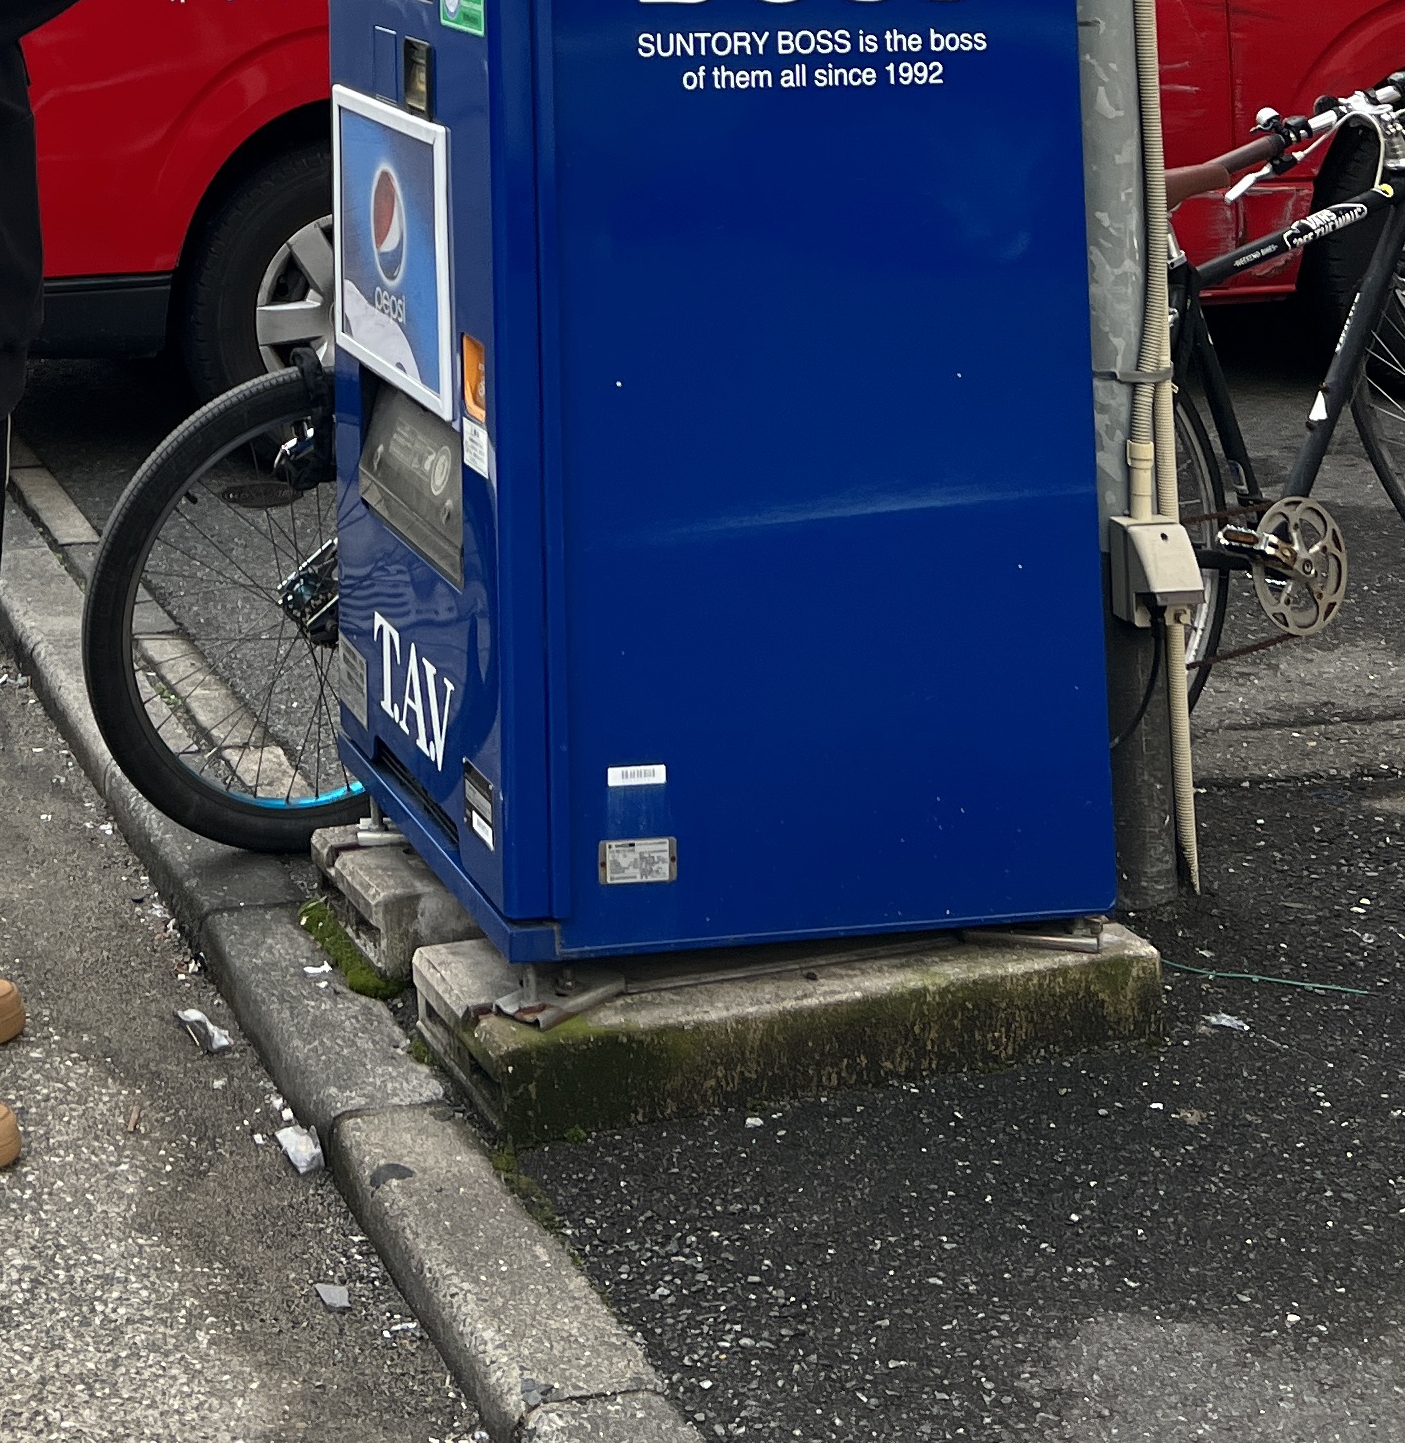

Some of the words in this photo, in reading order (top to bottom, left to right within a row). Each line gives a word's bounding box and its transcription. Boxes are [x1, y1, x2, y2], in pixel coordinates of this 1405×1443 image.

[637, 31, 770, 58] SUNTORY
[777, 29, 851, 56] BOSS
[858, 29, 878, 54] is
[885, 29, 923, 53] the
[929, 28, 987, 53] boss
[682, 65, 705, 90] of
[713, 64, 772, 90] them
[780, 63, 807, 88] all
[814, 62, 876, 87] since
[885, 61, 944, 86] 1992
[375, 286, 407, 326] pepsi
